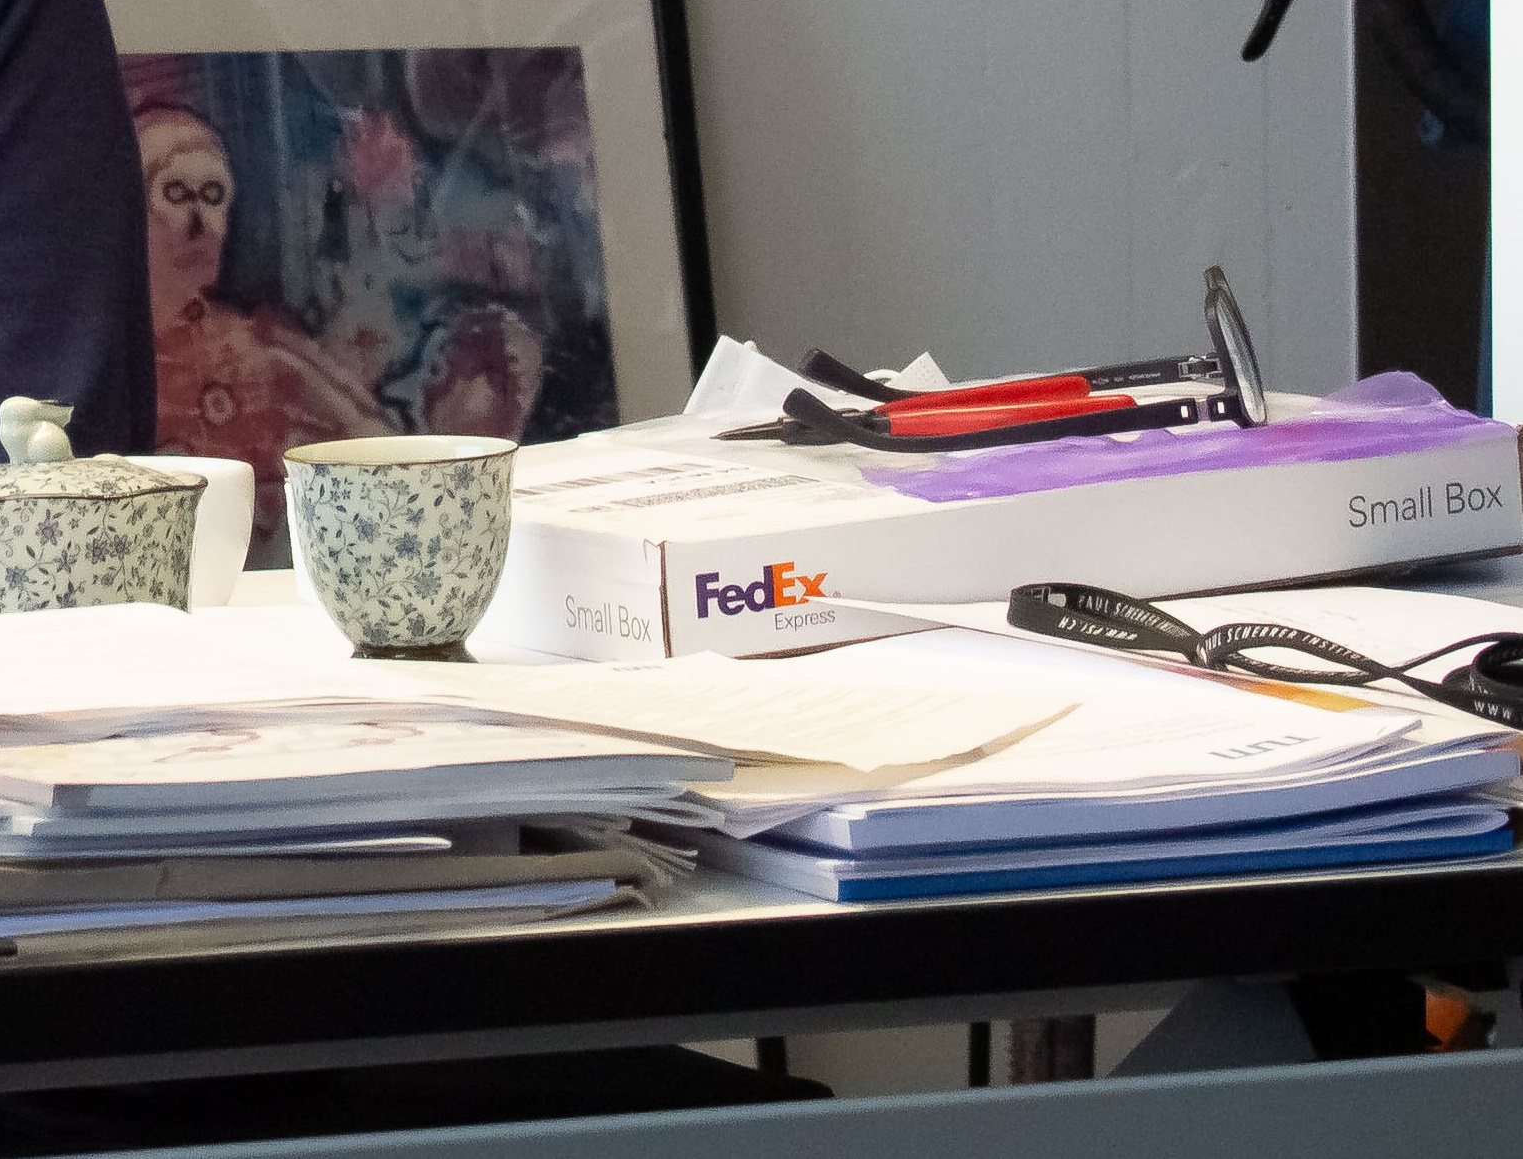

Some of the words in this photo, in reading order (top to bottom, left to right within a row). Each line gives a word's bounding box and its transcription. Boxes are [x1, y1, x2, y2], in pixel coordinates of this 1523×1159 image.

[1348, 486, 1433, 528] Small
[1446, 481, 1503, 515] Box
[695, 561, 828, 619] FedEx
[564, 594, 613, 635] Small
[618, 605, 652, 643] Box
[774, 609, 836, 632] Express
[1226, 625, 1298, 644] SCHERRER
